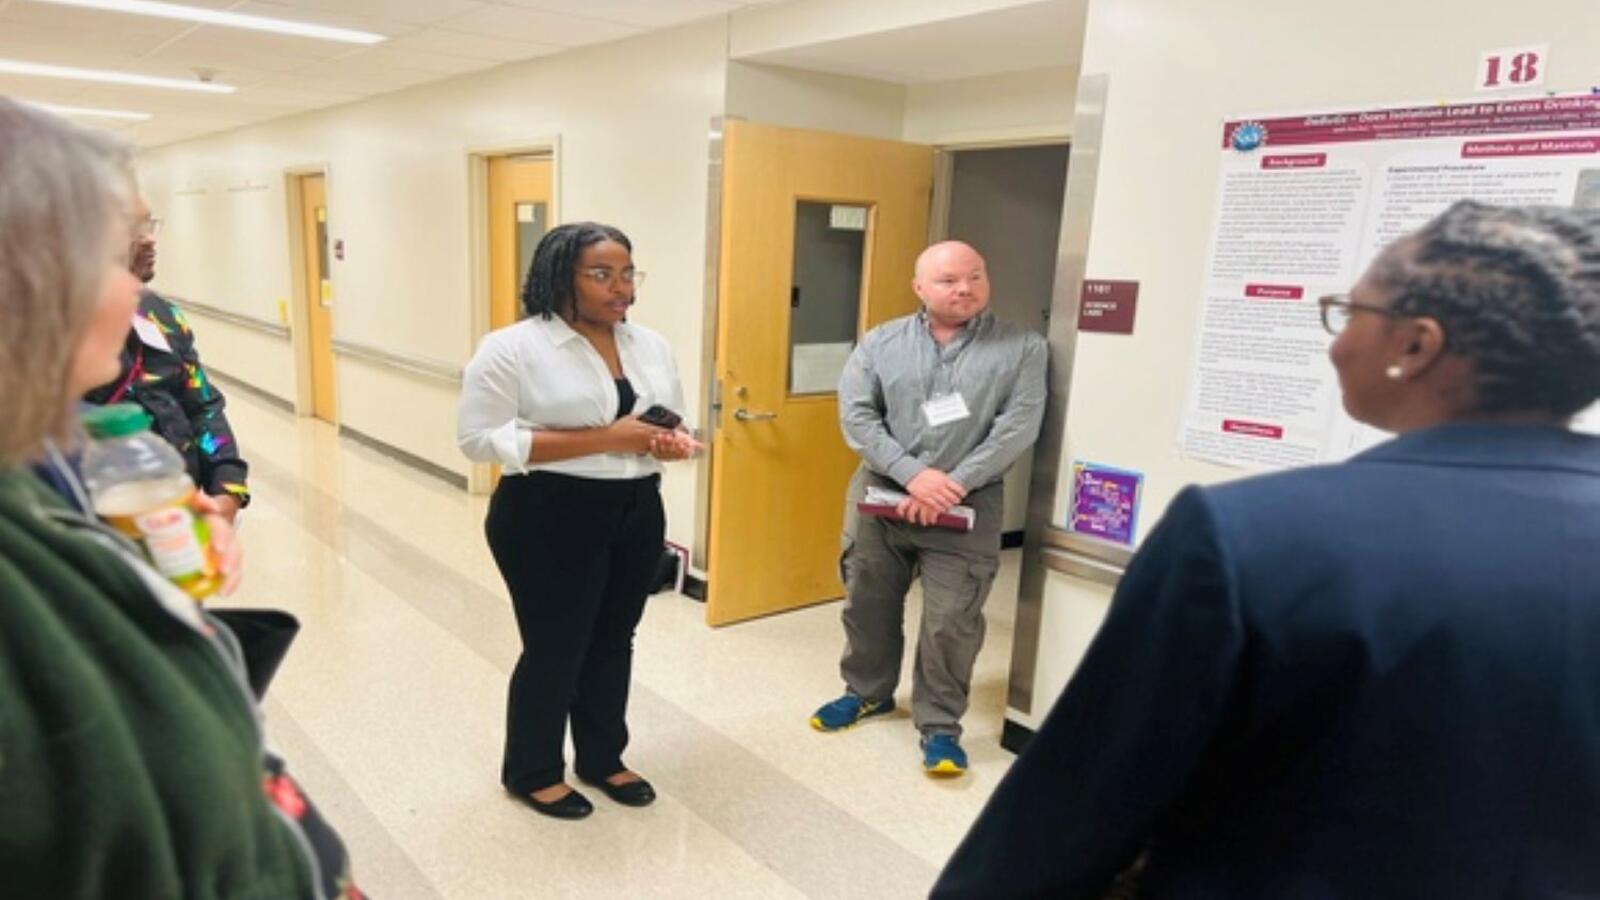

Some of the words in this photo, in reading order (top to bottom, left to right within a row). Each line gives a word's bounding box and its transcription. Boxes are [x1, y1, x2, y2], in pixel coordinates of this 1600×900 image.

[1483, 52, 1538, 87] 18
[1447, 105, 1476, 117] Lead
[1480, 104, 1494, 114] to
[1497, 101, 1540, 113] Excess
[1466, 142, 1515, 153] Methods
[1518, 141, 1539, 151] and
[1541, 139, 1595, 150] Materials
[1268, 156, 1320, 167] Background
